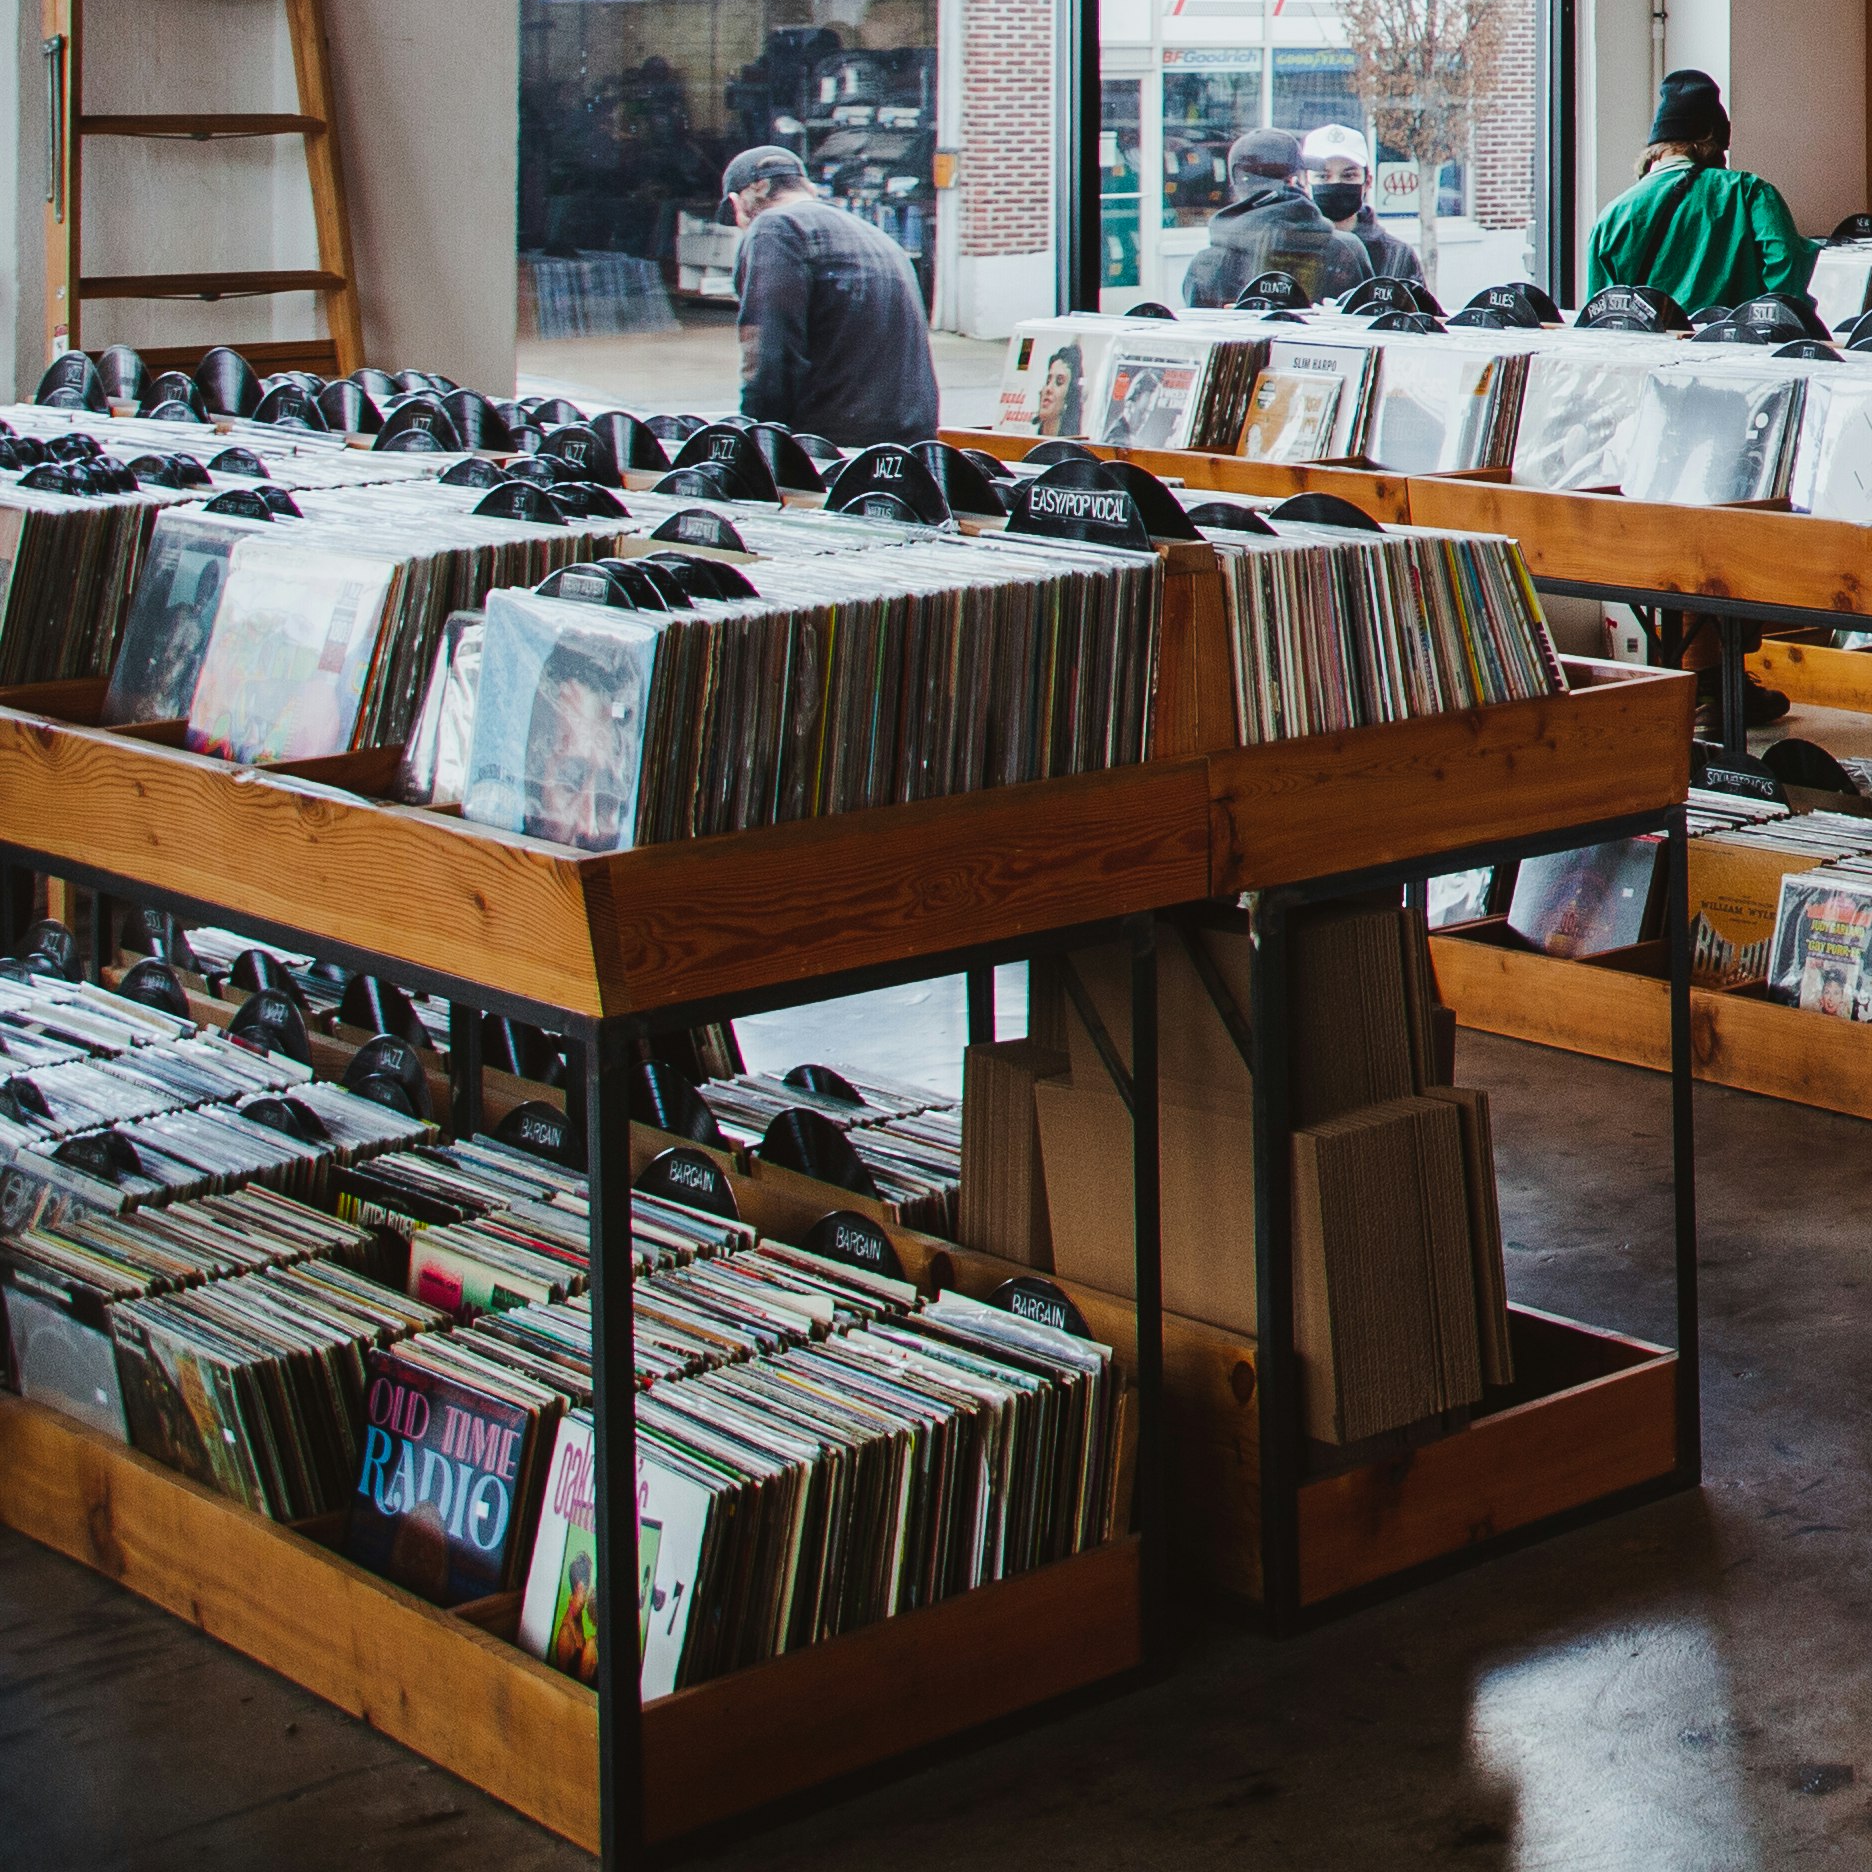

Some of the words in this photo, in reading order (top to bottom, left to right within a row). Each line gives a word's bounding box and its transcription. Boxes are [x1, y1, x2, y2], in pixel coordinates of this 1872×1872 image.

[1162, 50, 1257, 64] BFGoodrich
[1260, 280, 1293, 296] COUNTRY
[1373, 287, 1393, 301] FOLK
[1489, 291, 1515, 308] BLUES
[1752, 305, 1776, 323] SOUL
[1292, 357, 1310, 370] SLIM
[1312, 357, 1337, 372] HARPO
[708, 435, 738, 462] JAZZ
[873, 455, 903, 479] JAZZ
[1701, 901, 1744, 917] WILLIAM
[380, 1045, 405, 1067] JAZZ
[521, 1117, 562, 1148] BARGAIN
[669, 1159, 716, 1194] BARGAIN
[835, 1226, 883, 1262] BARGAIN
[1011, 1293, 1066, 1330] BARGAIN
[369, 1376, 430, 1441] OLD
[441, 1403, 522, 1481] TIME
[357, 1423, 511, 1551] RADIO
